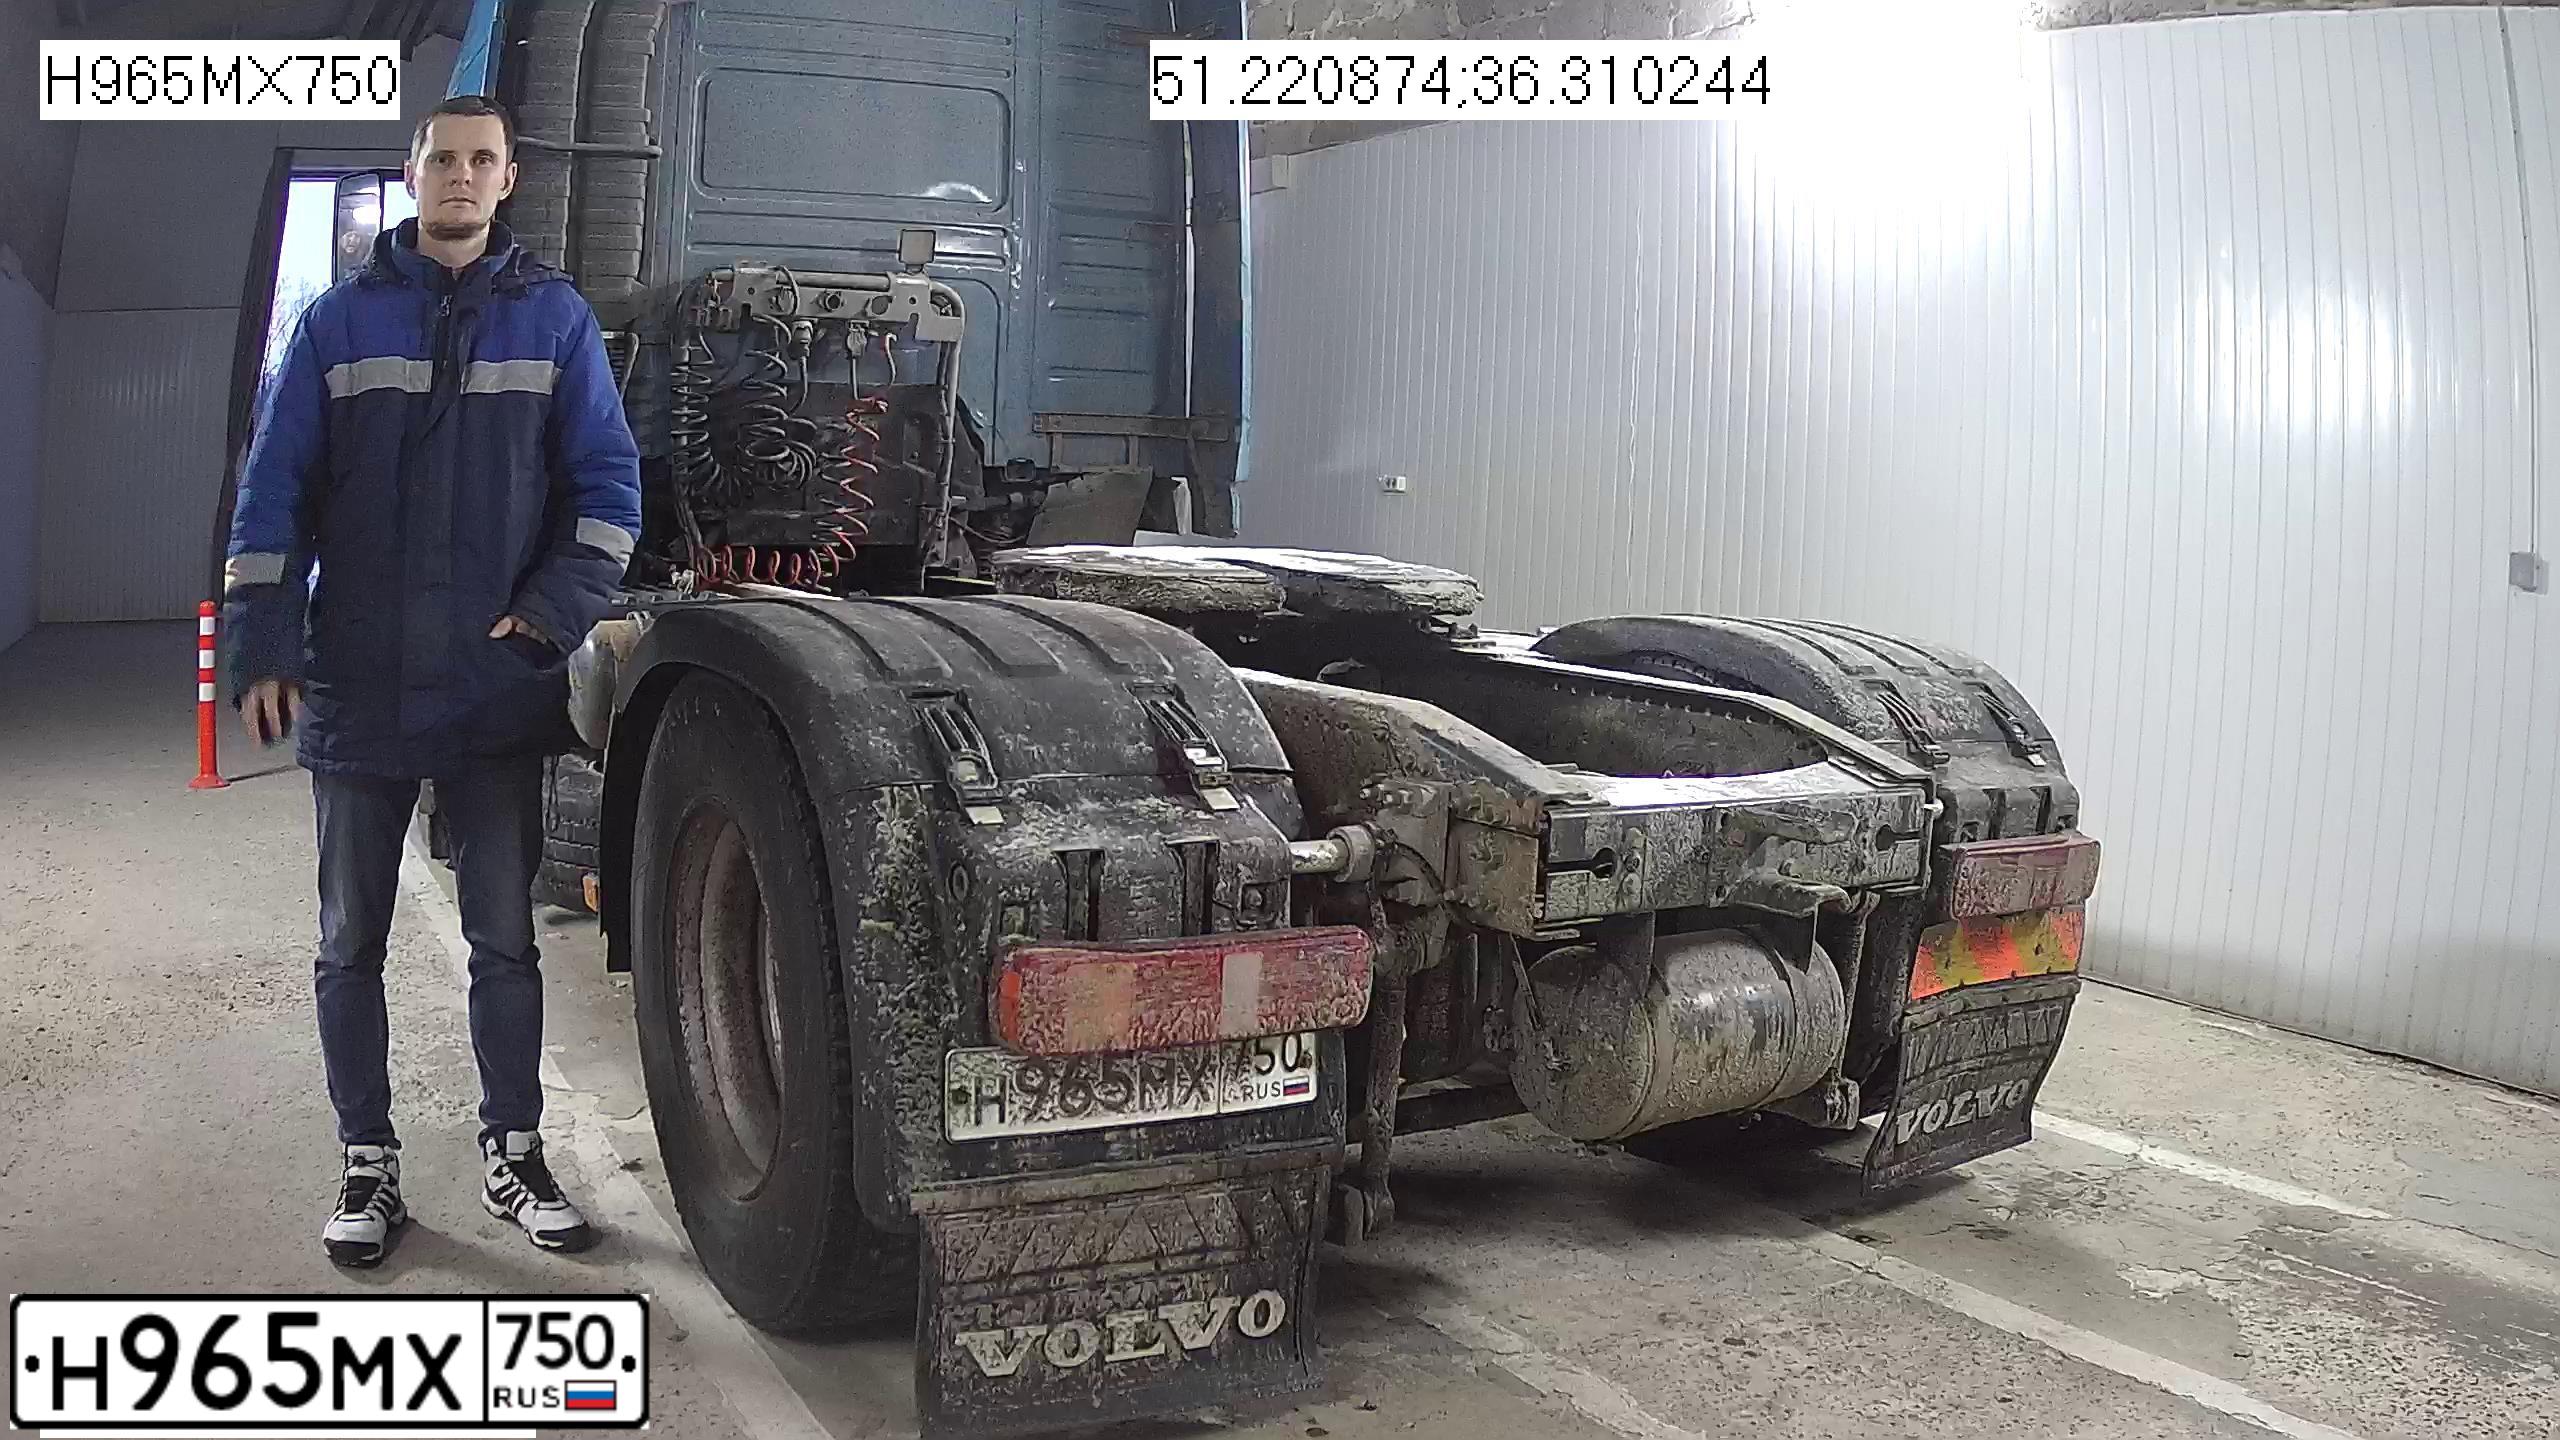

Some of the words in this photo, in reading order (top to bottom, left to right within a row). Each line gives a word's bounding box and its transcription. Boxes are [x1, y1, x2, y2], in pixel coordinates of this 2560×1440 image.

[1242, 1080, 1281, 1101] RUS
[1897, 1078, 2029, 1145] VOLVO
[954, 1289, 1287, 1377] VOLVO
